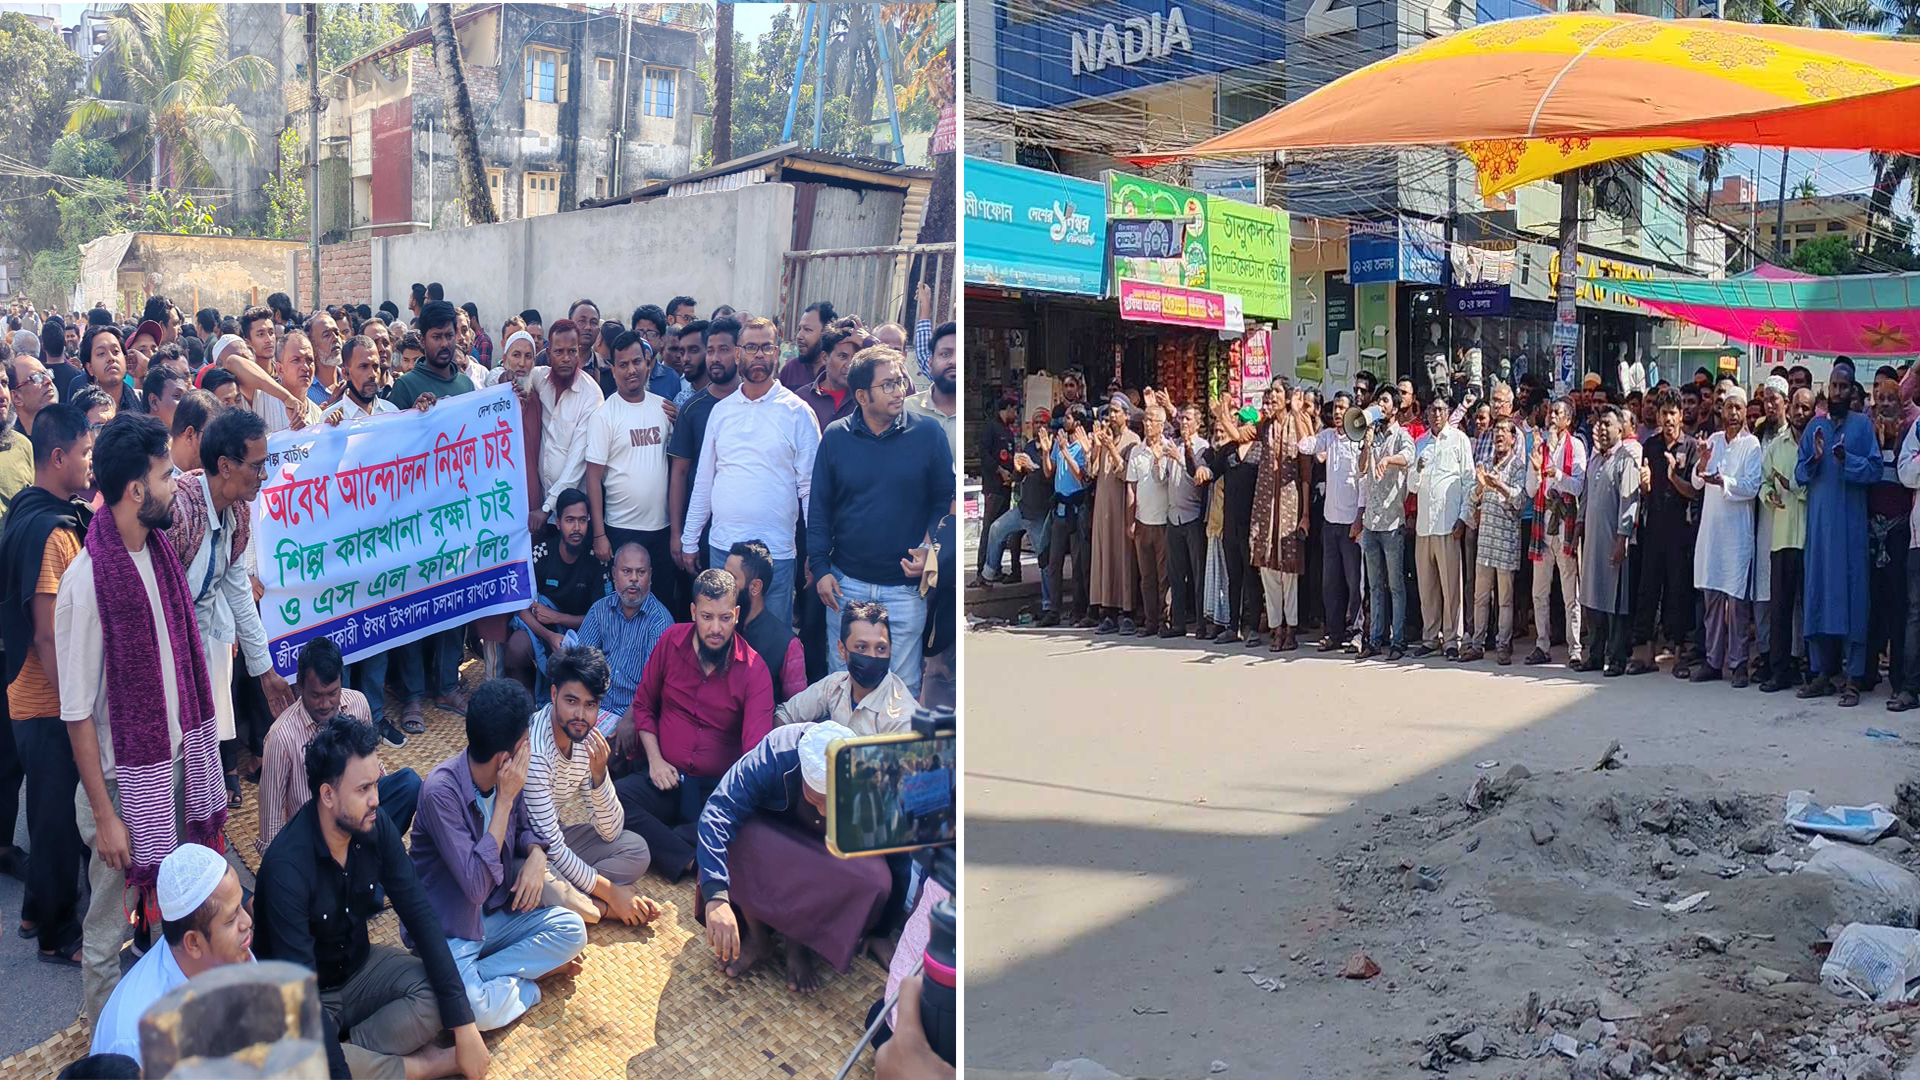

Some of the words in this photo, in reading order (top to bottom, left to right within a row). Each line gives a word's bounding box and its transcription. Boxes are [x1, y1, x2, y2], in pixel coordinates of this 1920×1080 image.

[1072, 6, 1193, 76] NADIA
[964, 191, 1013, 223] মীণফোন
[1222, 212, 1274, 251] তালুকদার
[478, 404, 491, 418] দেশ
[629, 426, 662, 447] NIKE
[261, 468, 331, 529] অবৈধ
[334, 452, 430, 511] আন্দোলন
[433, 424, 478, 493] নির্মূল
[481, 416, 515, 470] চাই
[273, 538, 328, 588] শিল্প
[332, 509, 423, 567] কারখানা
[427, 494, 472, 537] রক্ষা
[476, 478, 515, 521] চাই
[279, 597, 301, 626] ও
[313, 580, 360, 615] এস
[367, 564, 411, 598] এল
[475, 528, 509, 568] লিঃ
[276, 640, 308, 669] জীব
[361, 613, 387, 638] ঔষধ
[388, 599, 430, 629] উৎপাদন
[432, 588, 464, 616] চলমান
[466, 578, 498, 604] রাখতে
[499, 568, 520, 595] চাই
